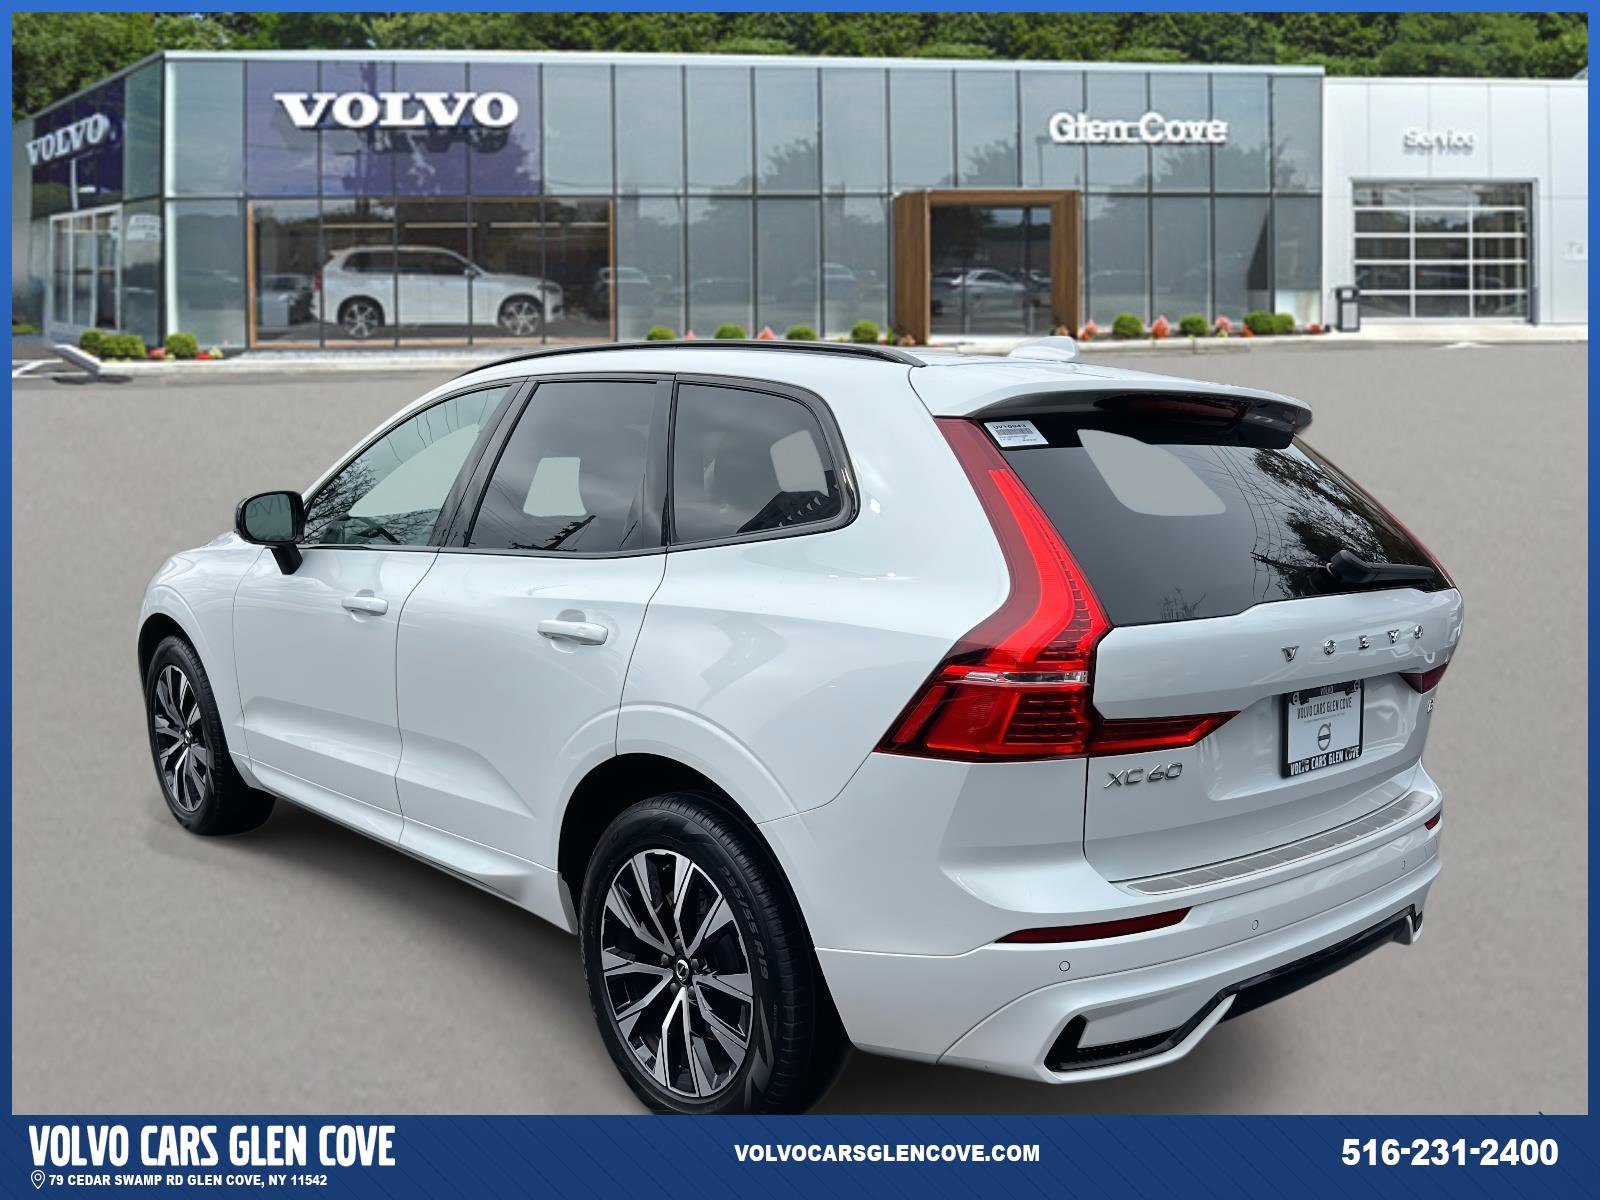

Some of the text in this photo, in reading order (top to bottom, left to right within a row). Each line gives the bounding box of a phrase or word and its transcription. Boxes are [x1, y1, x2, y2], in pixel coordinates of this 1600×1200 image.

[273, 91, 519, 128] VOLVO
[25, 112, 111, 166] VOLVO
[1049, 111, 1229, 144] Glen Cove
[1402, 127, 1476, 154] Service
[1281, 625, 1424, 662] VOLVO
[1297, 705, 1312, 719] VOLVO
[1313, 702, 1326, 716] CARS
[1326, 699, 1339, 713] GLEN
[1339, 697, 1352, 710] COVE
[1103, 762, 1183, 789] XC60
[1311, 754, 1327, 770] CARS
[1328, 750, 1344, 765] GLEN
[754, 939, 769, 980] R19
